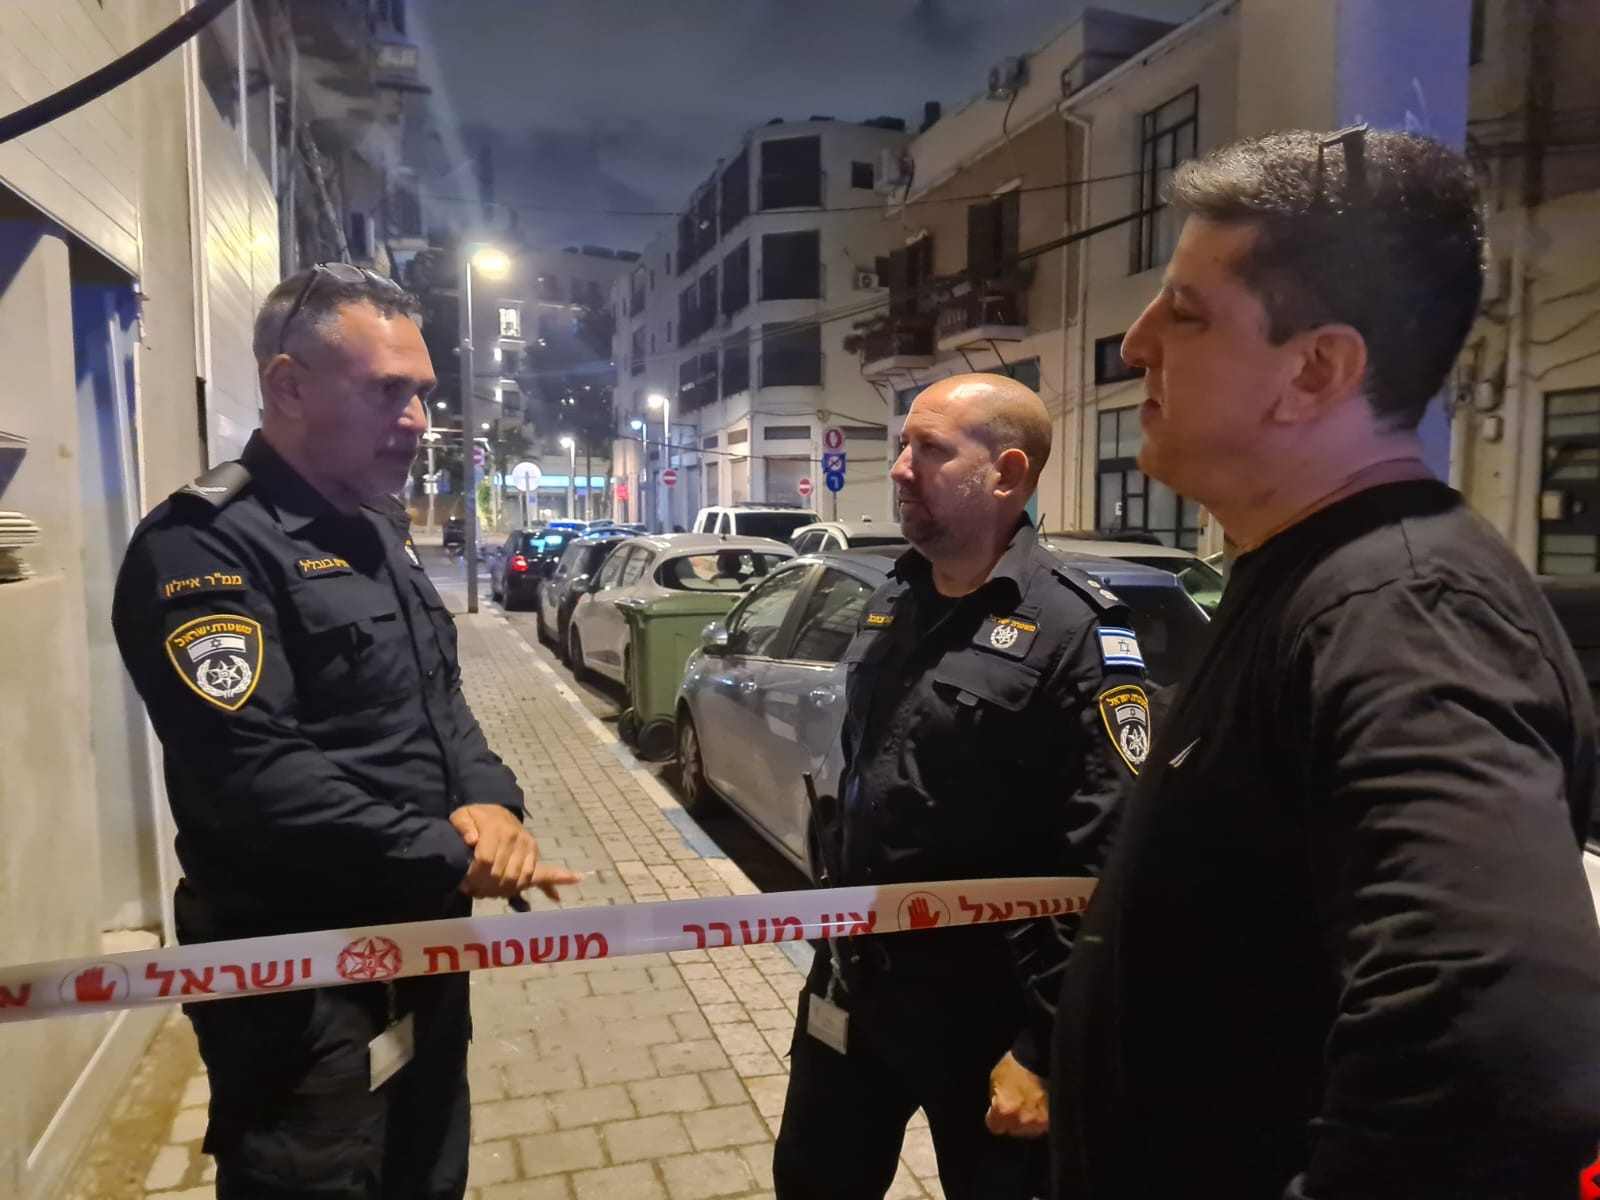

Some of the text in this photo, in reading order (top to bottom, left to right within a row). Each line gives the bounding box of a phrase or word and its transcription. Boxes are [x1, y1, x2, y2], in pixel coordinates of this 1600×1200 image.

[165, 577, 201, 597] איילון
[174, 622, 253, 648] משטרת ישראל
[958, 895, 1088, 923] ישראל
[682, 910, 877, 950] אין מעבר
[422, 931, 609, 974] משטרת
[144, 957, 313, 997] ישראל
